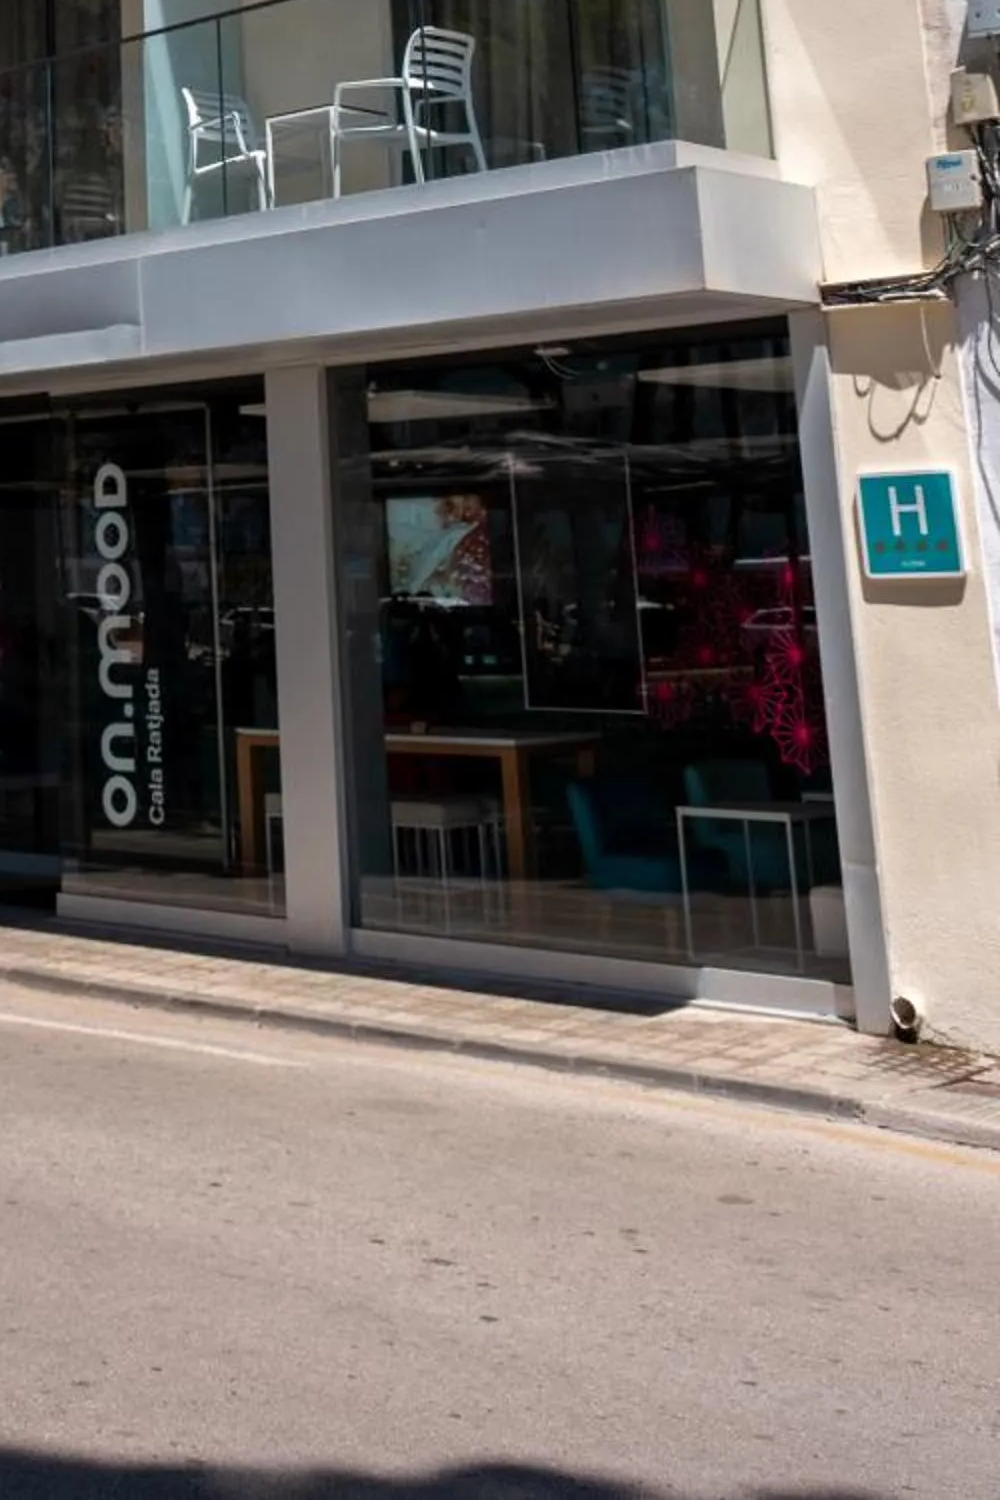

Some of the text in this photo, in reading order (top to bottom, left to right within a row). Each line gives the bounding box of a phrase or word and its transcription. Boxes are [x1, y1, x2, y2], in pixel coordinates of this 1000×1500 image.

[888, 484, 929, 536] H
[147, 667, 165, 825] Cala Ratjada
